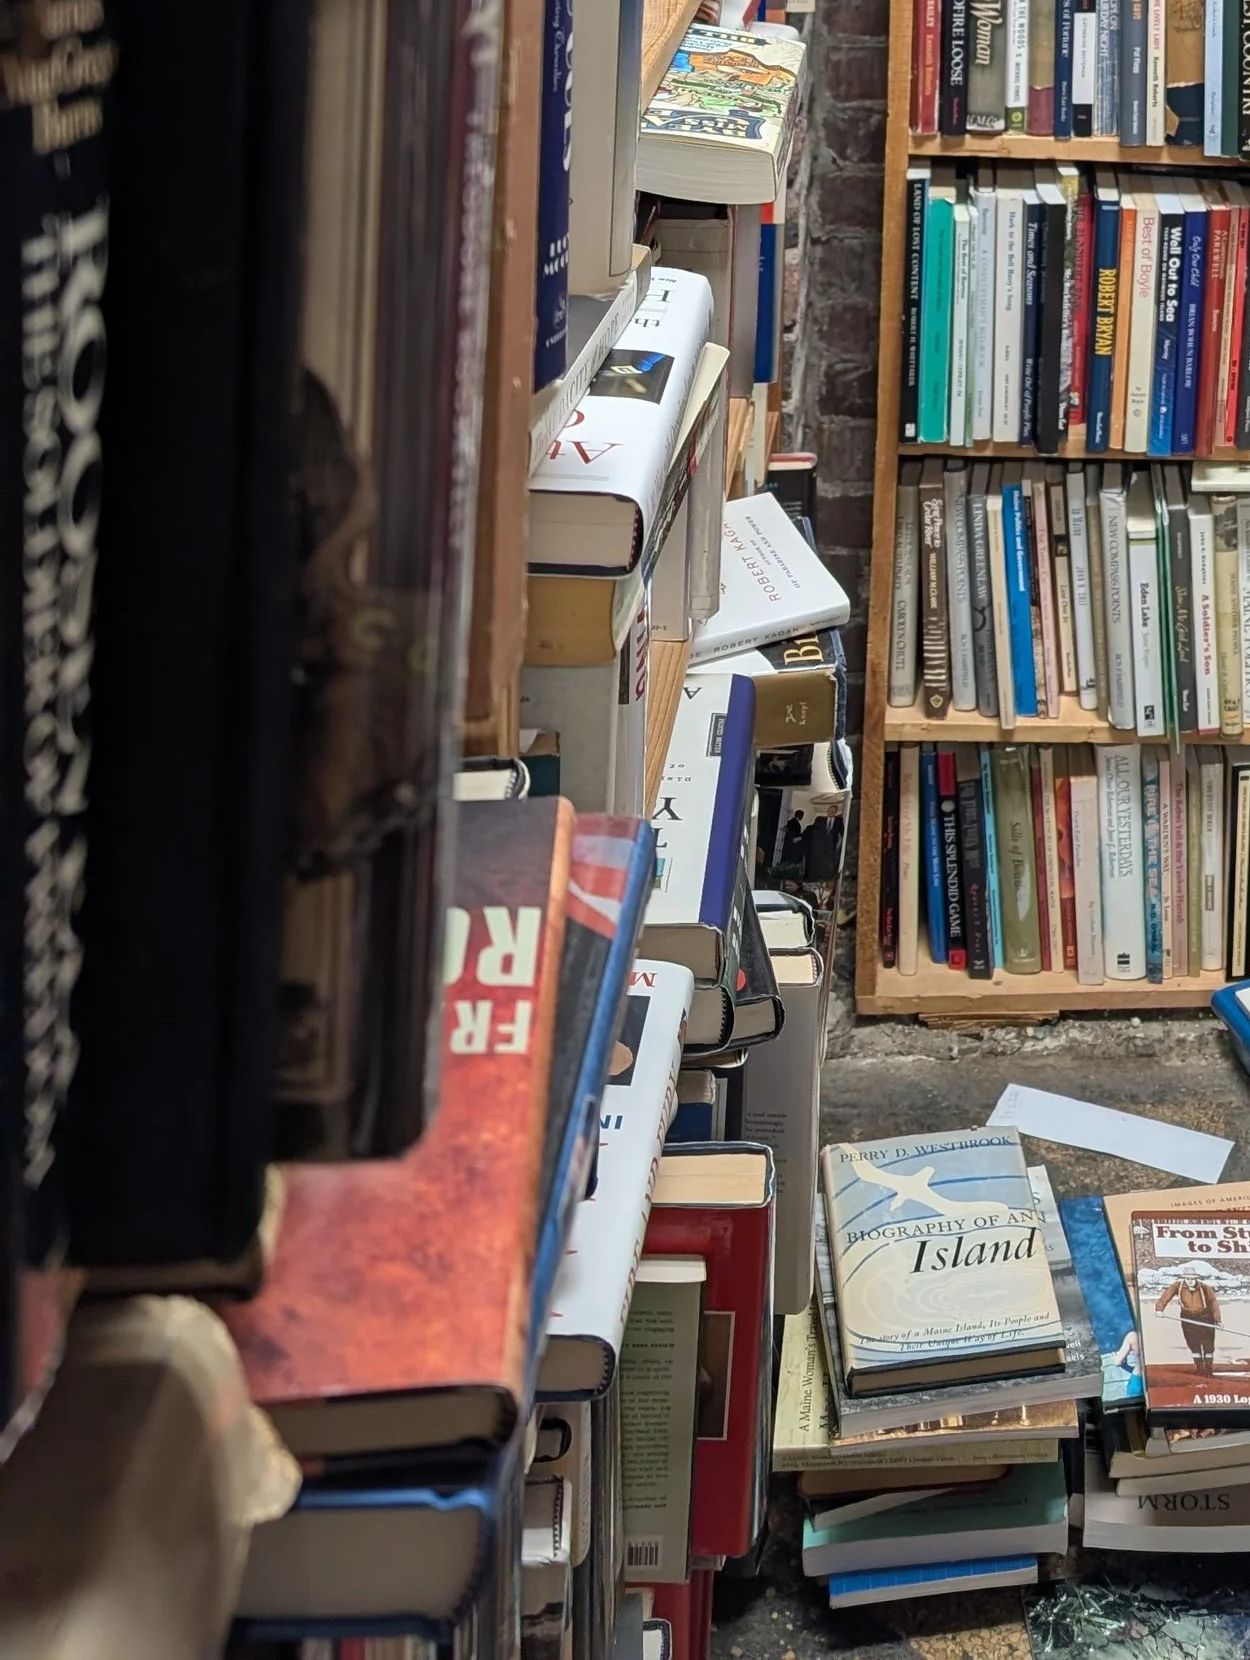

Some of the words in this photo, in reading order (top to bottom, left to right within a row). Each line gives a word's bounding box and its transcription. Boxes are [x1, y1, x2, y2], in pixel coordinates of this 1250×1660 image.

[971, 0, 1002, 65] Woman
[950, 40, 963, 85] LOOSE
[1142, 217, 1154, 245] Best
[1168, 227, 1180, 254] Well
[1141, 248, 1154, 262] of
[1138, 264, 1152, 298] Boyle
[1168, 258, 1179, 281] Out
[1097, 268, 1115, 312] ROBERT
[1167, 284, 1179, 297] to
[1166, 299, 1178, 322] Sea
[1095, 316, 1114, 355] BRYAN
[972, 503, 982, 538] LINDA
[1108, 516, 1118, 539] NEW
[723, 522, 746, 551] KAGA
[975, 541, 986, 599] GREENLAW
[1109, 541, 1120, 586] COMPASS
[741, 556, 781, 602] ROBERT
[1111, 588, 1121, 623] POINTS
[1140, 583, 1149, 605] Eden
[1141, 608, 1150, 627] Lake
[713, 636, 759, 653] ROBERT
[764, 626, 800, 641] KAGAN
[799, 701, 807, 725] Knopf
[1117, 755, 1130, 778] ALL
[1117, 780, 1131, 806] OUR
[944, 814, 954, 842] THIS
[1118, 807, 1133, 877] YESTERDAYS
[946, 844, 958, 902] SPLENDID
[949, 904, 960, 937] GAME
[840, 1149, 888, 1163] PERRY
[895, 1148, 910, 1158] D.
[915, 1136, 1012, 1155] WESTBROOK
[1171, 1200, 1203, 1208] IMAGES
[846, 1218, 966, 1243] BIOGRAPHY
[973, 1214, 999, 1227] OF
[1155, 1226, 1218, 1239] From
[910, 1227, 1037, 1274] Island
[1189, 1242, 1212, 1253] to
[801, 1344, 816, 1384] Woman's
[800, 1387, 813, 1418] Maine
[1193, 1394, 1202, 1404] A
[1204, 1394, 1231, 1404] 1930
[799, 1421, 810, 1432] A
[1137, 1493, 1231, 1512] STORM
